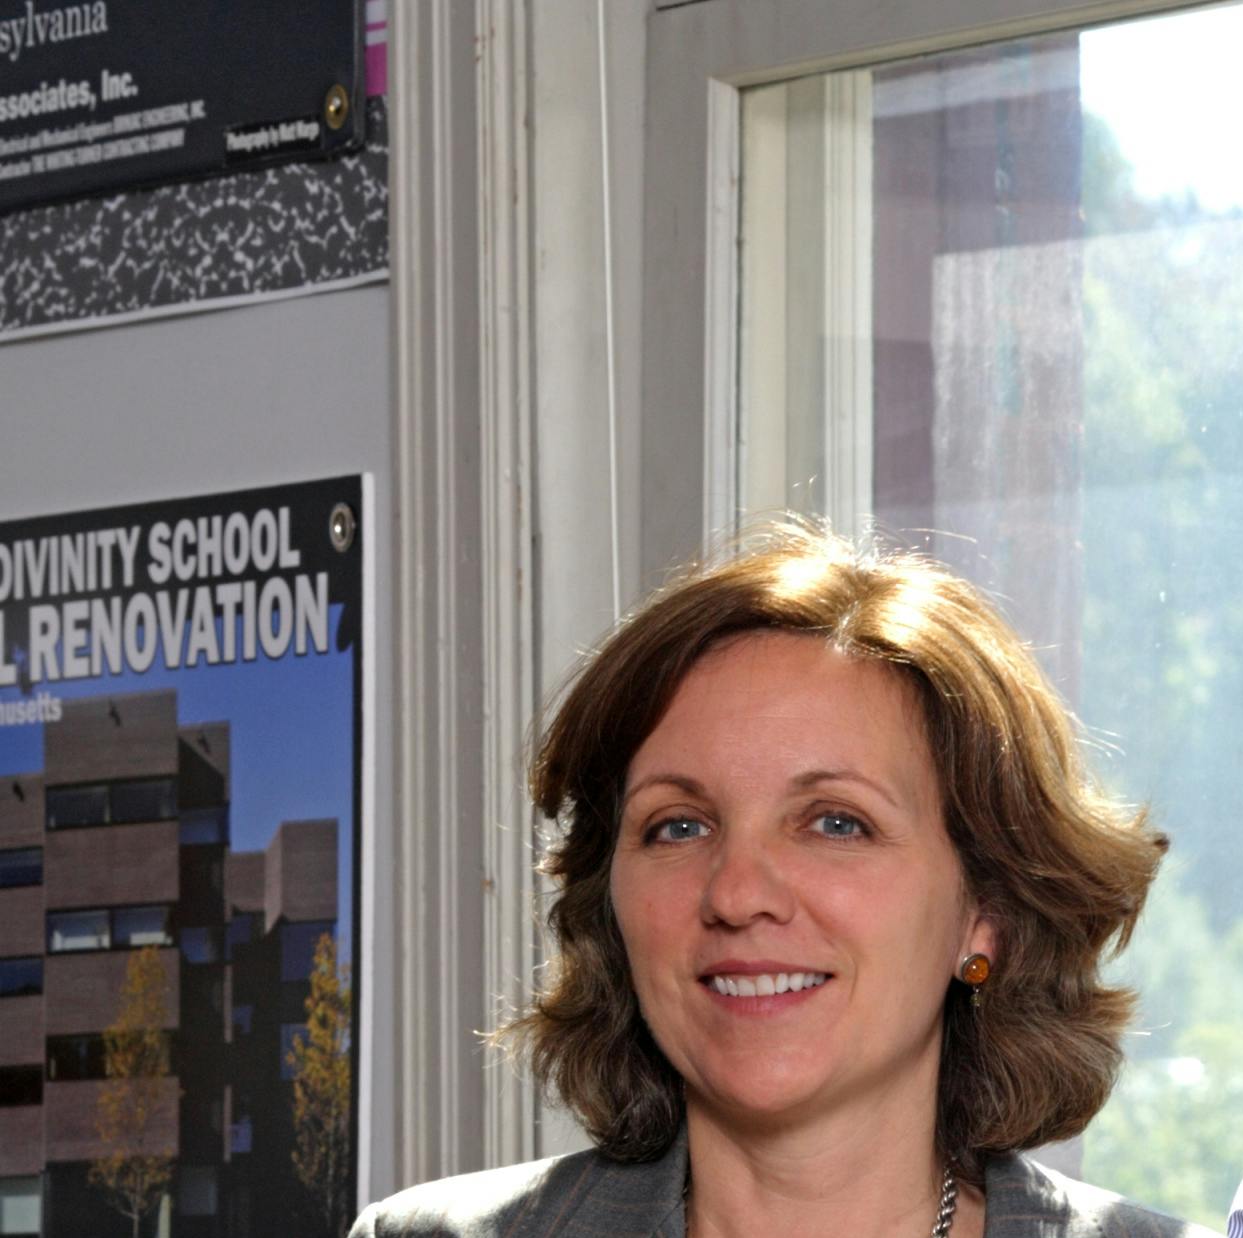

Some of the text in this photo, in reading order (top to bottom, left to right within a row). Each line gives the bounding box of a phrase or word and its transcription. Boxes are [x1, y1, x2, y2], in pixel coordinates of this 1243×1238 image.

[101, 69, 138, 101] Inc.
[0, 506, 301, 601] DIVINITY SCHOOL
[29, 572, 329, 682] RENOVATION
